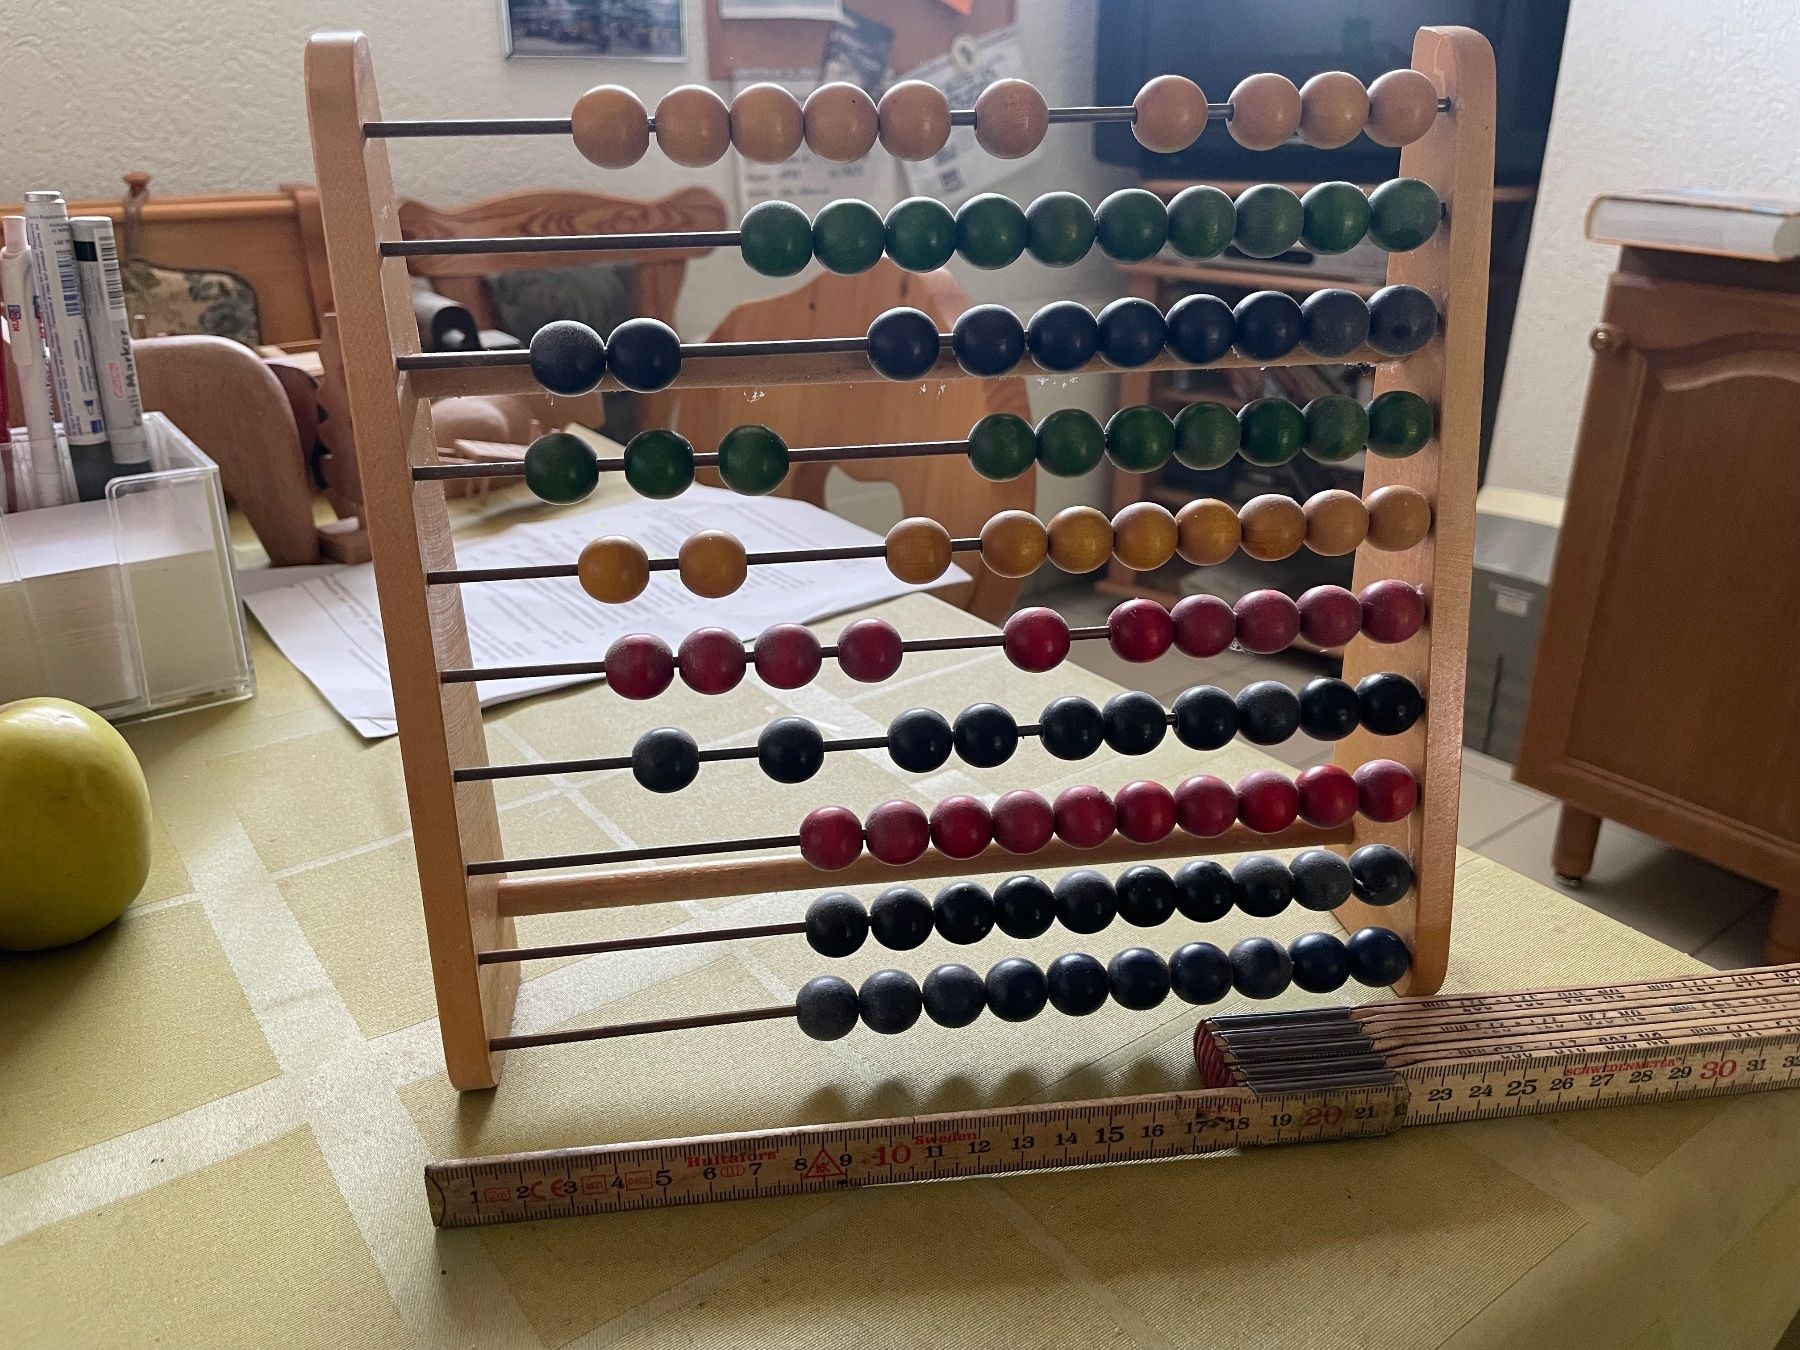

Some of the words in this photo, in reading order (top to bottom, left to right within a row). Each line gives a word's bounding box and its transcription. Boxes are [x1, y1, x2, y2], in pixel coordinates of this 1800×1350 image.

[1428, 1088, 1453, 1102] 23
[1468, 1084, 1493, 1098] 24
[1505, 1078, 1538, 1097] 25
[1549, 1077, 1574, 1091] 26
[1589, 1073, 1614, 1087] 27
[1628, 1069, 1654, 1083] 28
[1668, 1066, 1692, 1080] 29
[1700, 1059, 1737, 1080] 30
[1747, 1058, 1766, 1072] 31
[516, 1185, 530, 1199] 2
[563, 1181, 578, 1194] 3
[610, 1176, 625, 1189] 4
[655, 1169, 673, 1187] 5
[703, 1167, 717, 1180] 6
[749, 1162, 762, 1176] 7
[794, 1158, 808, 1171] 8
[839, 1153, 853, 1167] 9
[875, 1144, 912, 1167] 10
[926, 1144, 945, 1159] 11
[967, 1140, 991, 1154] 12
[1012, 1136, 1035, 1150] 13
[1055, 1131, 1078, 1146] 14
[1095, 1126, 1124, 1144] 15
[1141, 1124, 1164, 1138] 16
[1184, 1119, 1208, 1135] 17
[1226, 1117, 1250, 1131] 18
[1270, 1113, 1292, 1127] 19
[1302, 1105, 1344, 1127] 20
[1354, 1106, 1376, 1120] 21
